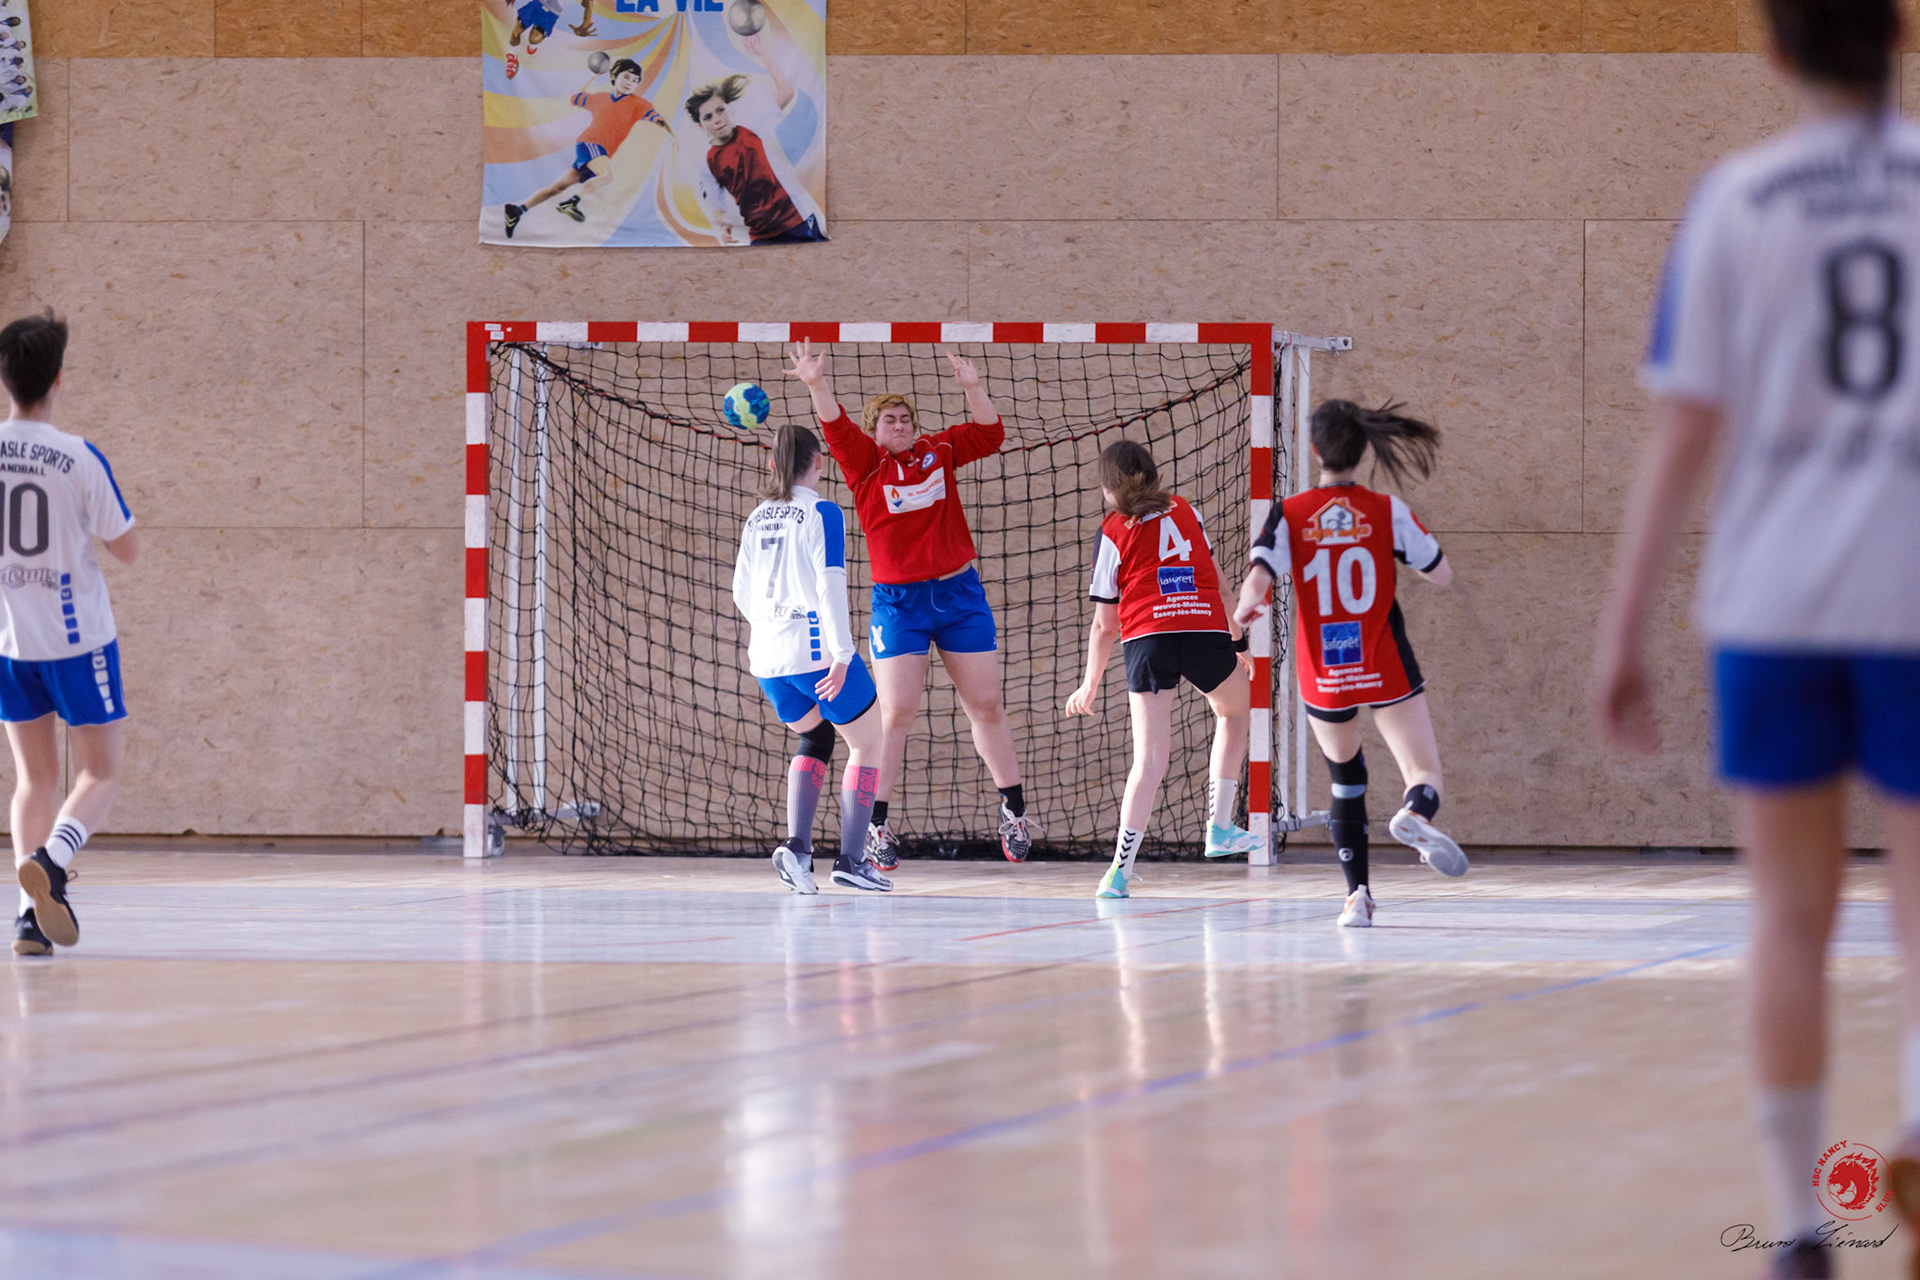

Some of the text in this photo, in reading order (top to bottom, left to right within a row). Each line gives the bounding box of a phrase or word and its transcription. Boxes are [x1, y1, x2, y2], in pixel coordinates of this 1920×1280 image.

[1821, 235, 1904, 402] 8
[29, 443, 75, 474] SPORTS
[1159, 516, 1192, 561] 4
[761, 536, 785, 598] 7
[1303, 546, 1377, 616] 10
[1152, 602, 1211, 612] Neuves-Maisons
[1166, 595, 1198, 603] Agences
